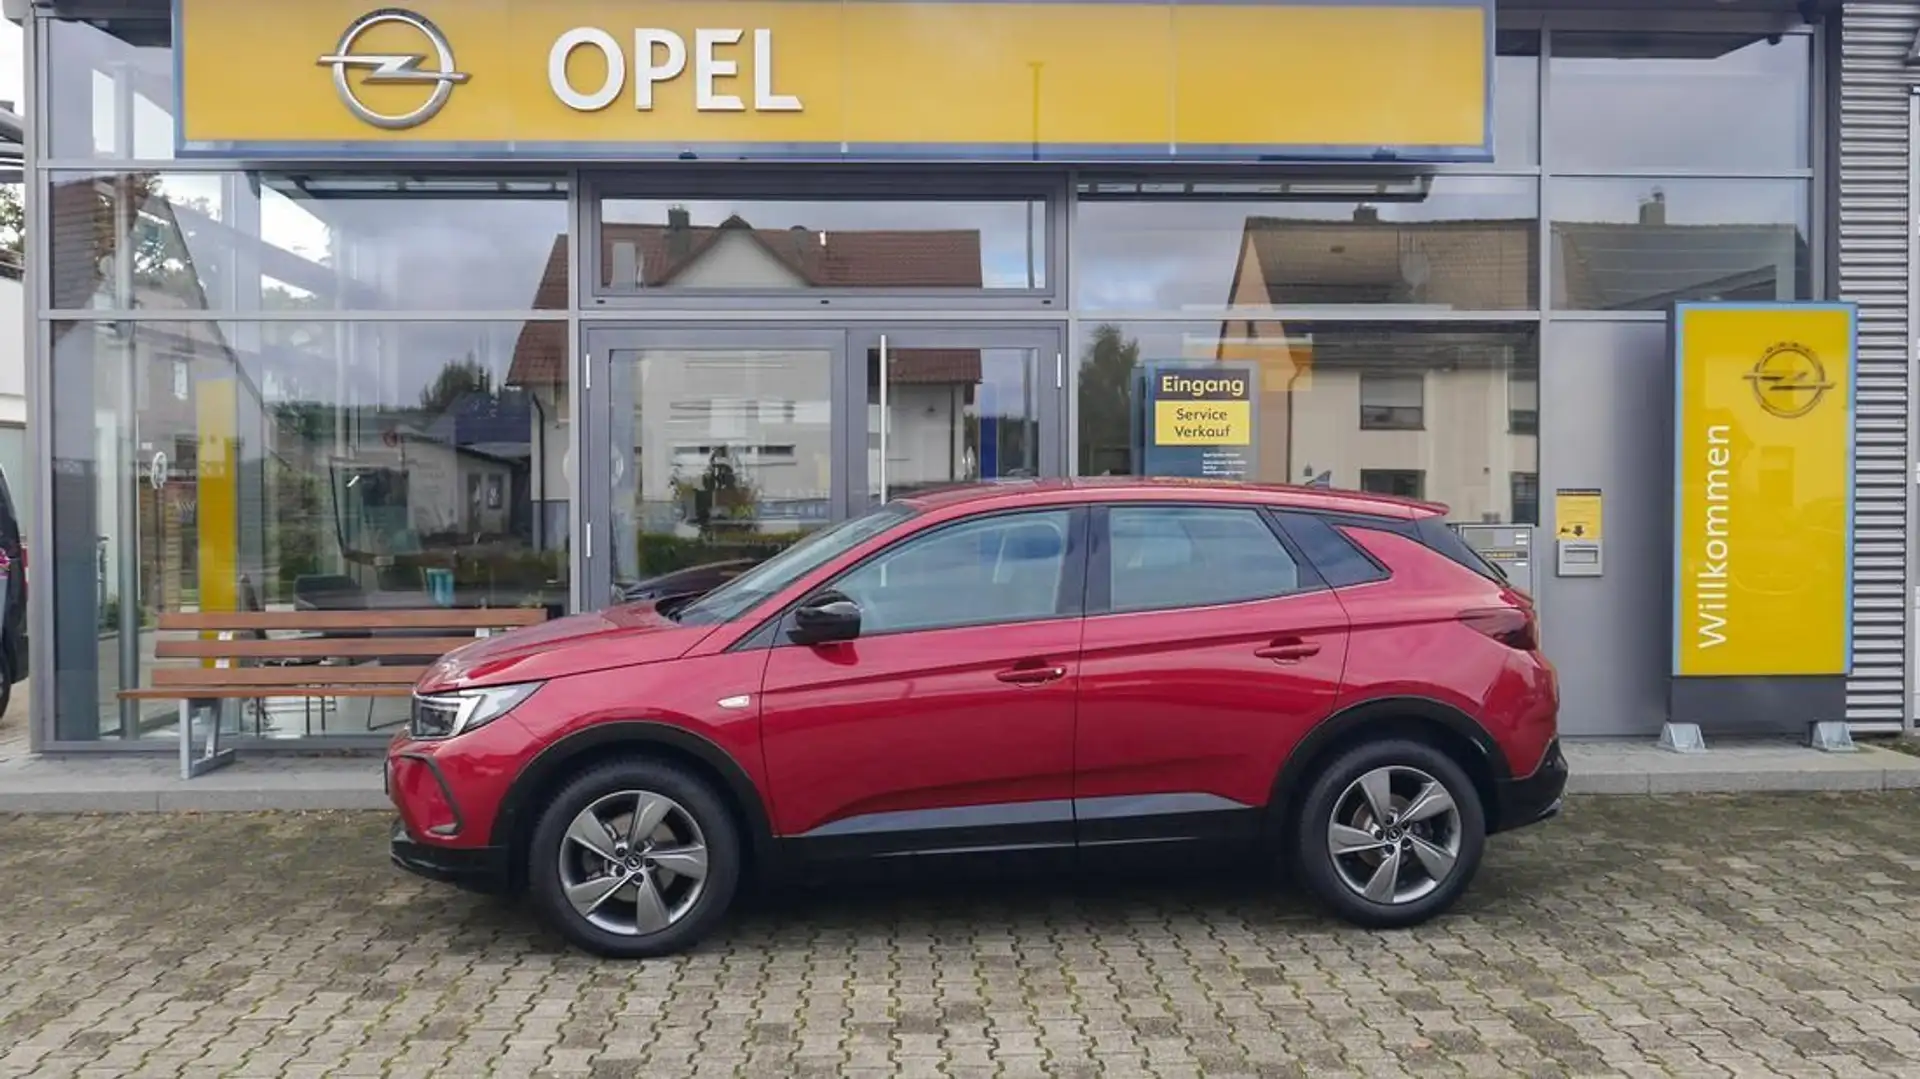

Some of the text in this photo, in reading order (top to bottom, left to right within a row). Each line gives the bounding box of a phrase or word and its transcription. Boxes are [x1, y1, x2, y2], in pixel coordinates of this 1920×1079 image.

[548, 26, 803, 111] OPEL
[1162, 375, 1244, 396] Eingang
[1175, 407, 1228, 421] Service
[1174, 424, 1231, 438] Verkauf
[1697, 424, 1730, 649] Willkommen
